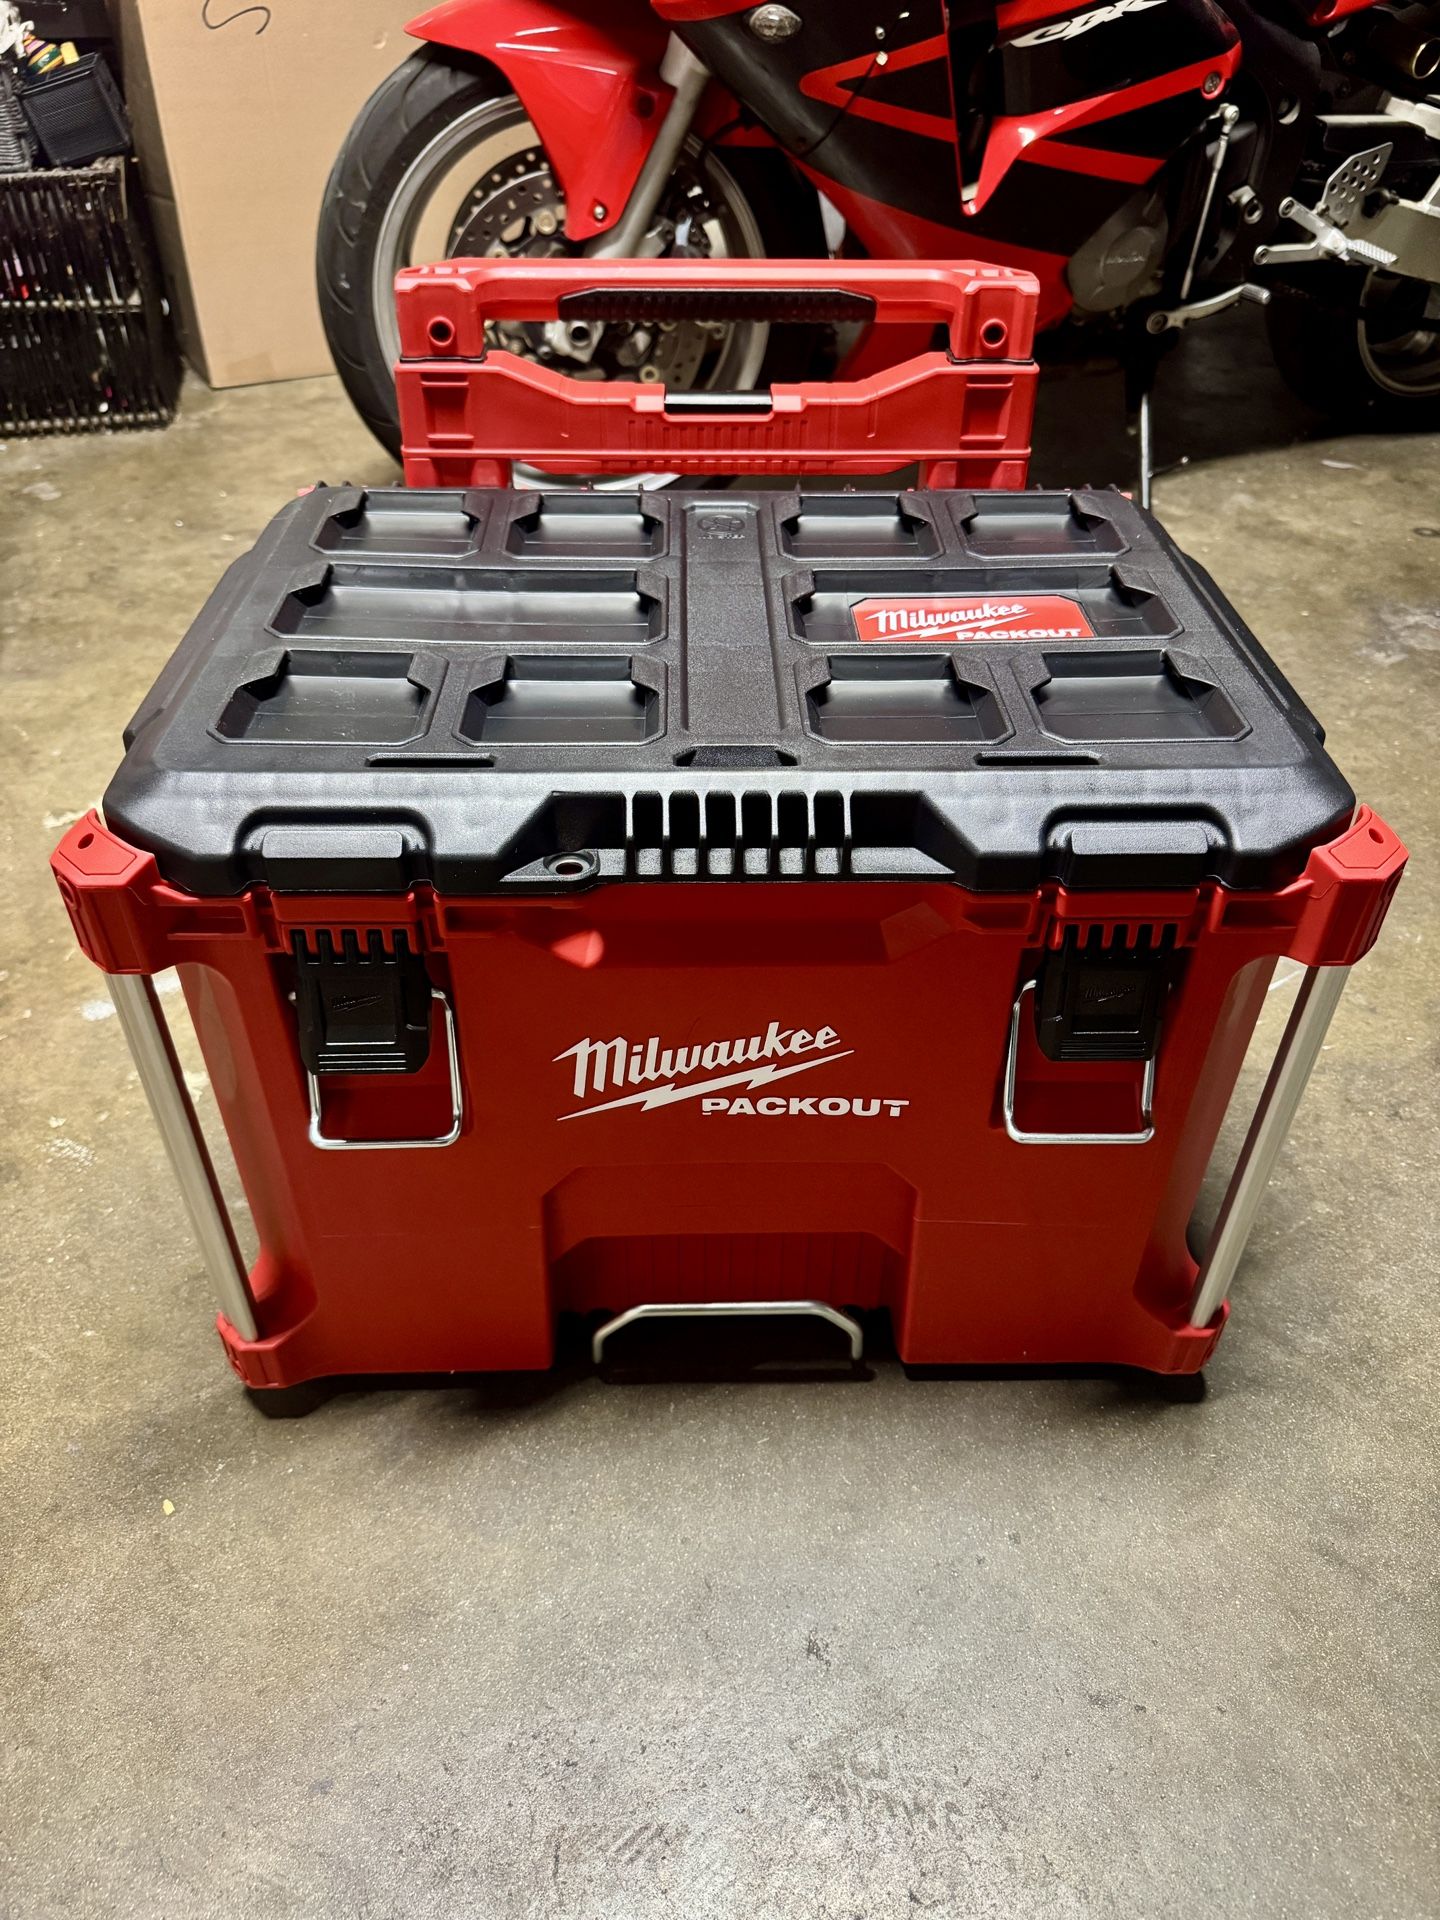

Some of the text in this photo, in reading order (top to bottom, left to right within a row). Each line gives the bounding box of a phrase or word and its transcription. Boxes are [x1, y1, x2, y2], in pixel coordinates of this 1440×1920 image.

[864, 603, 1028, 633] Milwaukee
[956, 628, 1082, 641] PACKOUT
[552, 1021, 841, 1099] Milwaukee
[702, 1097, 910, 1117] PACKOUT
